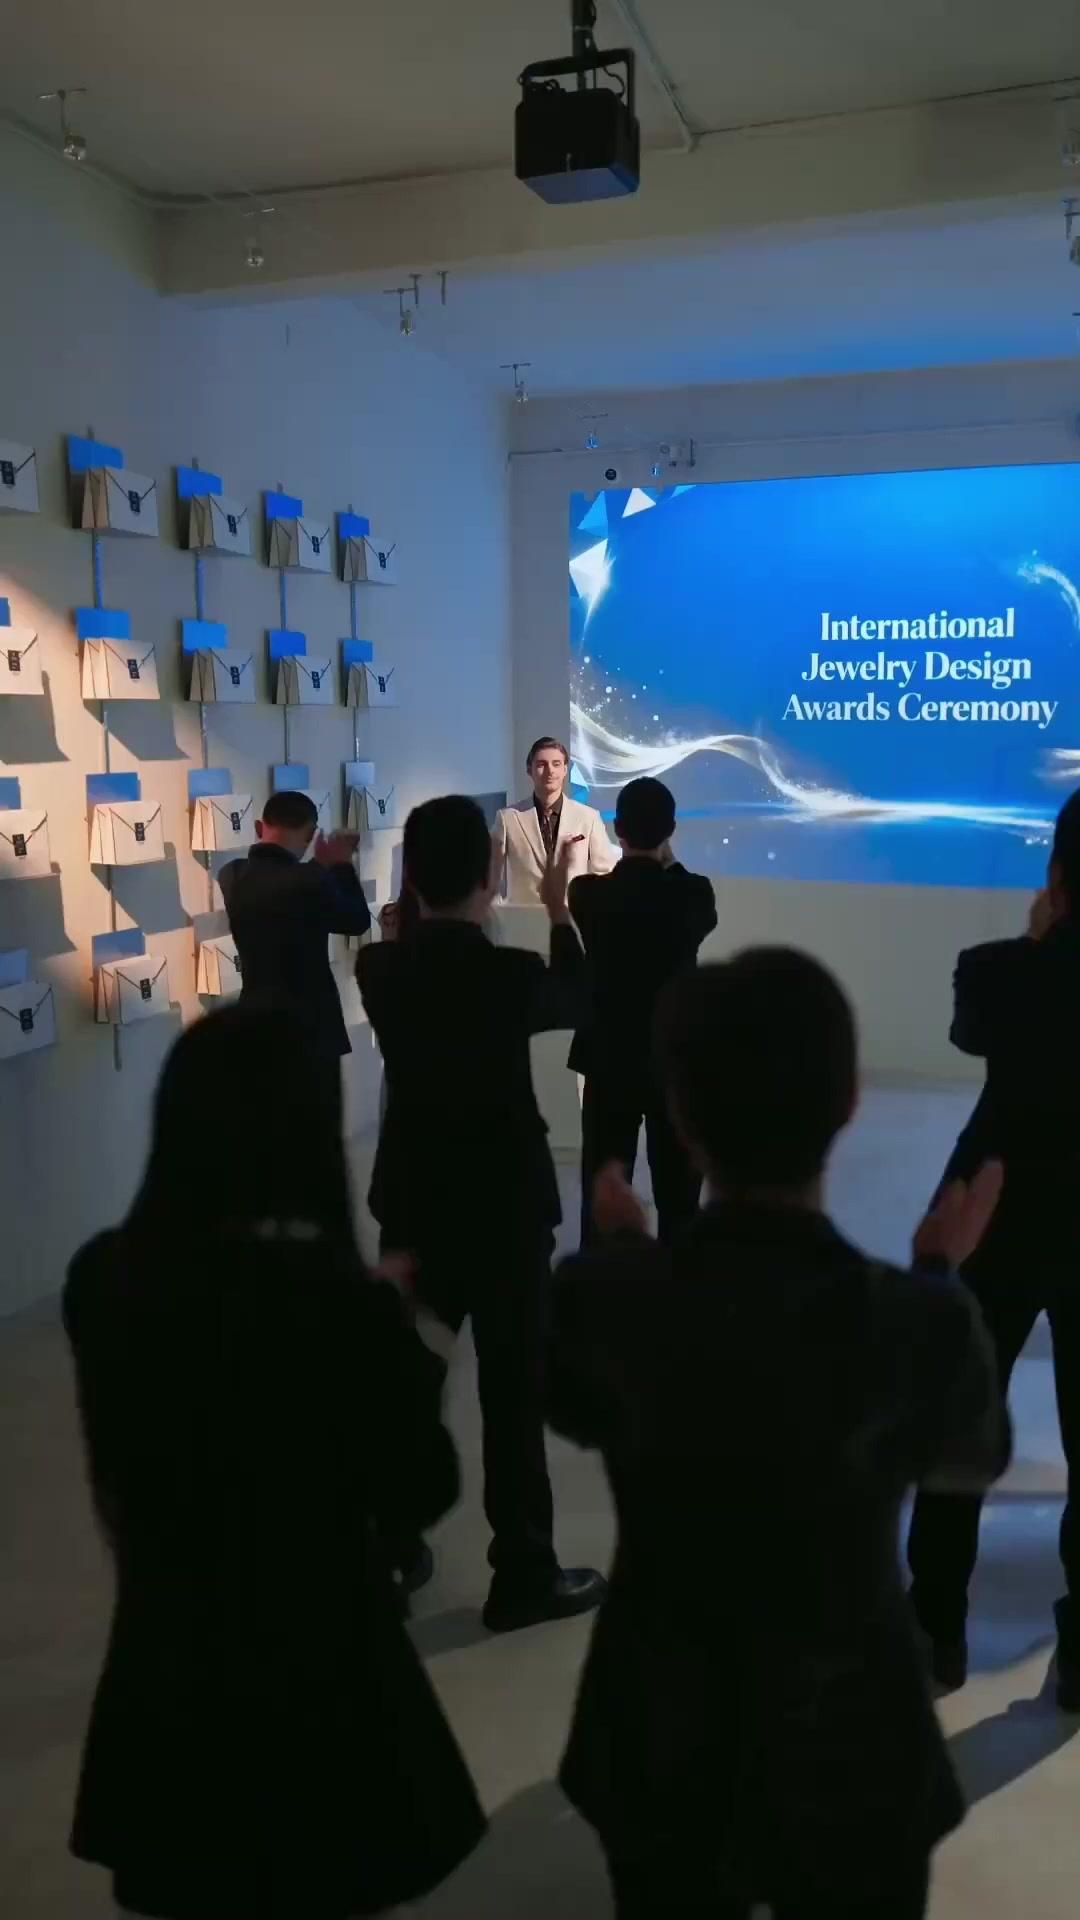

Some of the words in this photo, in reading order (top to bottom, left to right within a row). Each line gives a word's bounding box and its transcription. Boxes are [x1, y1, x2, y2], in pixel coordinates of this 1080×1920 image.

[821, 607, 1015, 640] International
[801, 651, 917, 688] Jewelry
[924, 650, 1032, 690] Design
[782, 692, 890, 721] Awards
[898, 692, 1059, 729] Ceremony
